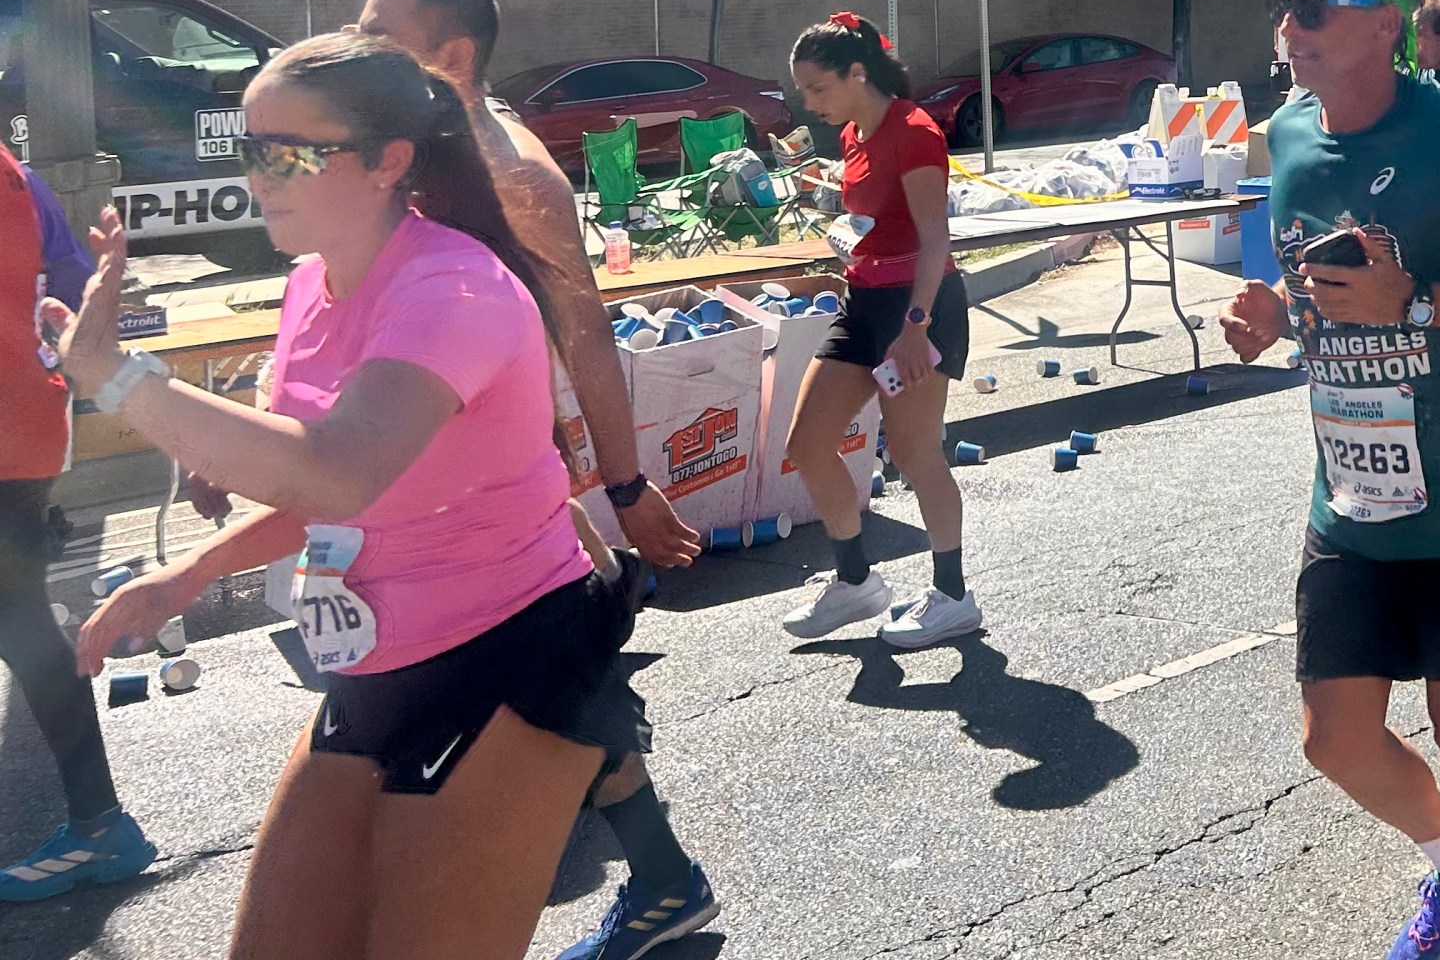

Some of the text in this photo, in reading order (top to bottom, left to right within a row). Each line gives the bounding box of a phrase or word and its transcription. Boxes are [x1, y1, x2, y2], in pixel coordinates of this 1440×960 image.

[202, 141, 228, 154] 106
[1319, 330, 1427, 357] ANGELES
[1345, 400, 1383, 409] ANGELES
[1330, 405, 1384, 419] MARATHON
[1323, 436, 1411, 474] 12263
[678, 473, 714, 493] Customers
[714, 467, 724, 477] Go
[1362, 484, 1383, 497] asics
